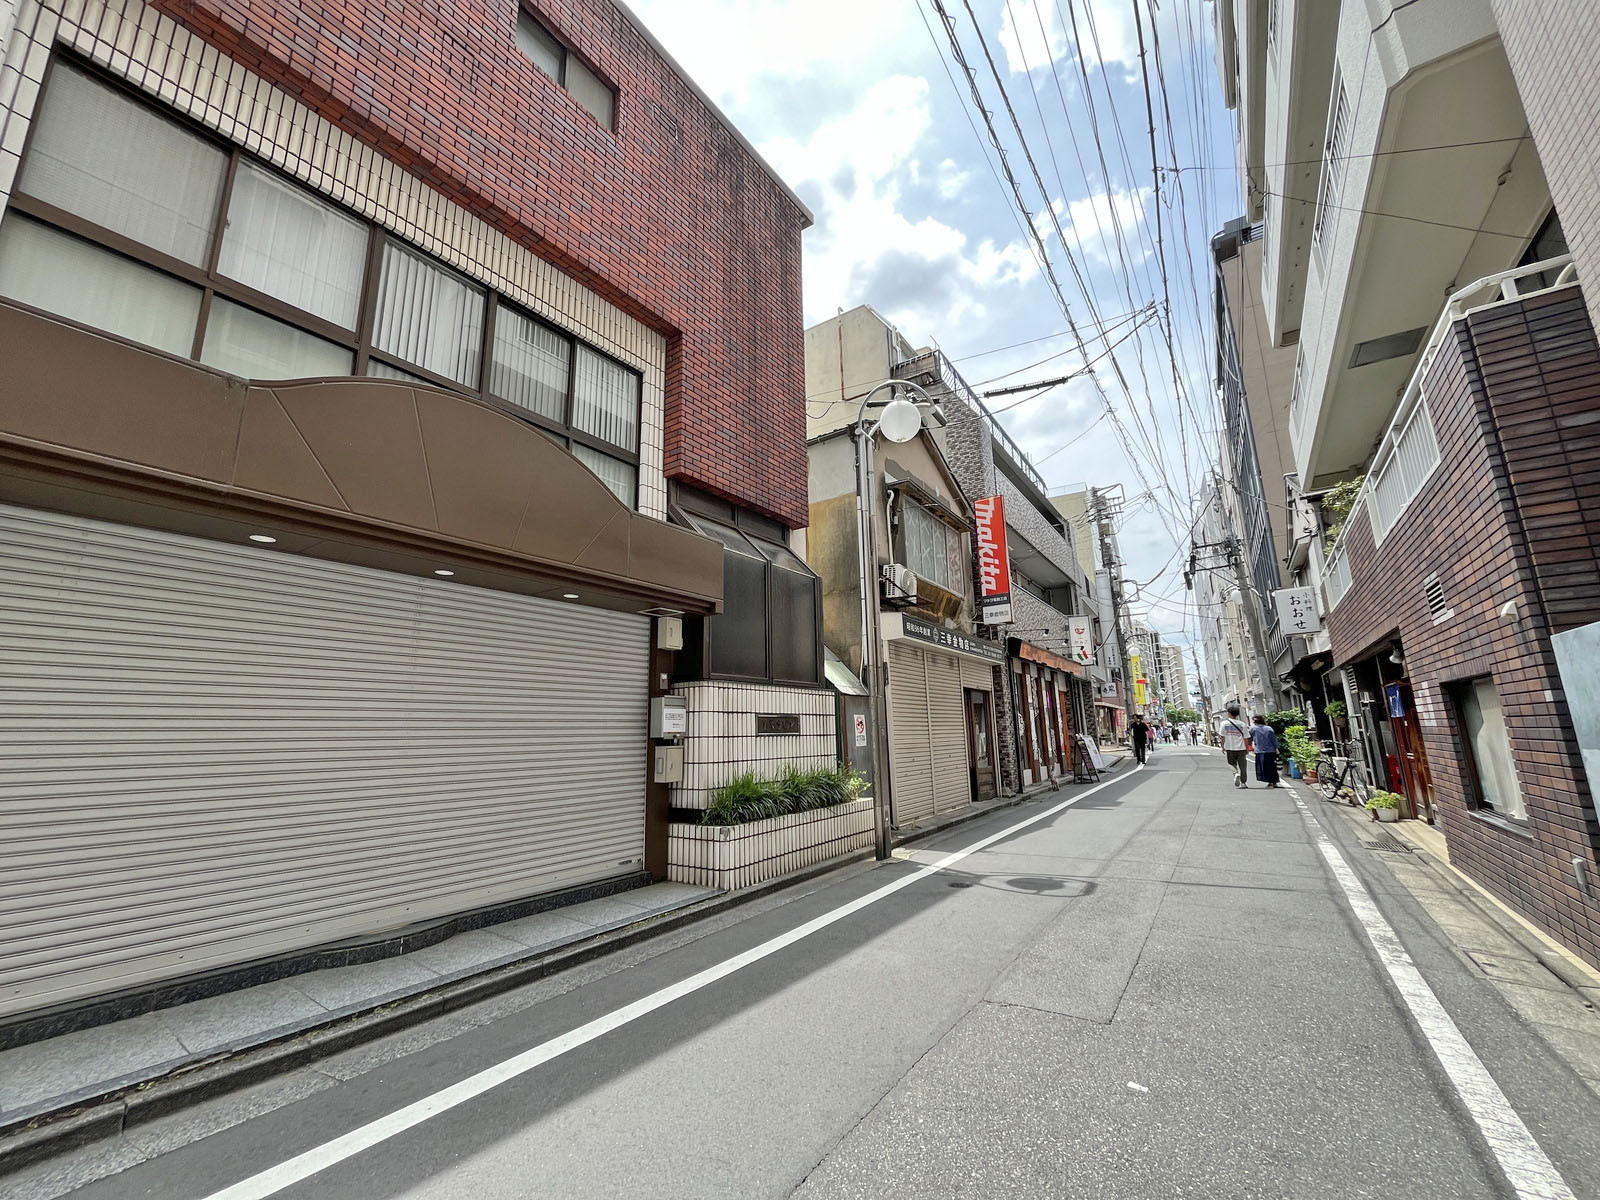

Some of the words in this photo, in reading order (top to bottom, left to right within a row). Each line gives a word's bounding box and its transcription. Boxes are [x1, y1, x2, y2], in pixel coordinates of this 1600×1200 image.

[974, 497, 1001, 597] makita
[1290, 595, 1306, 629] おおせ
